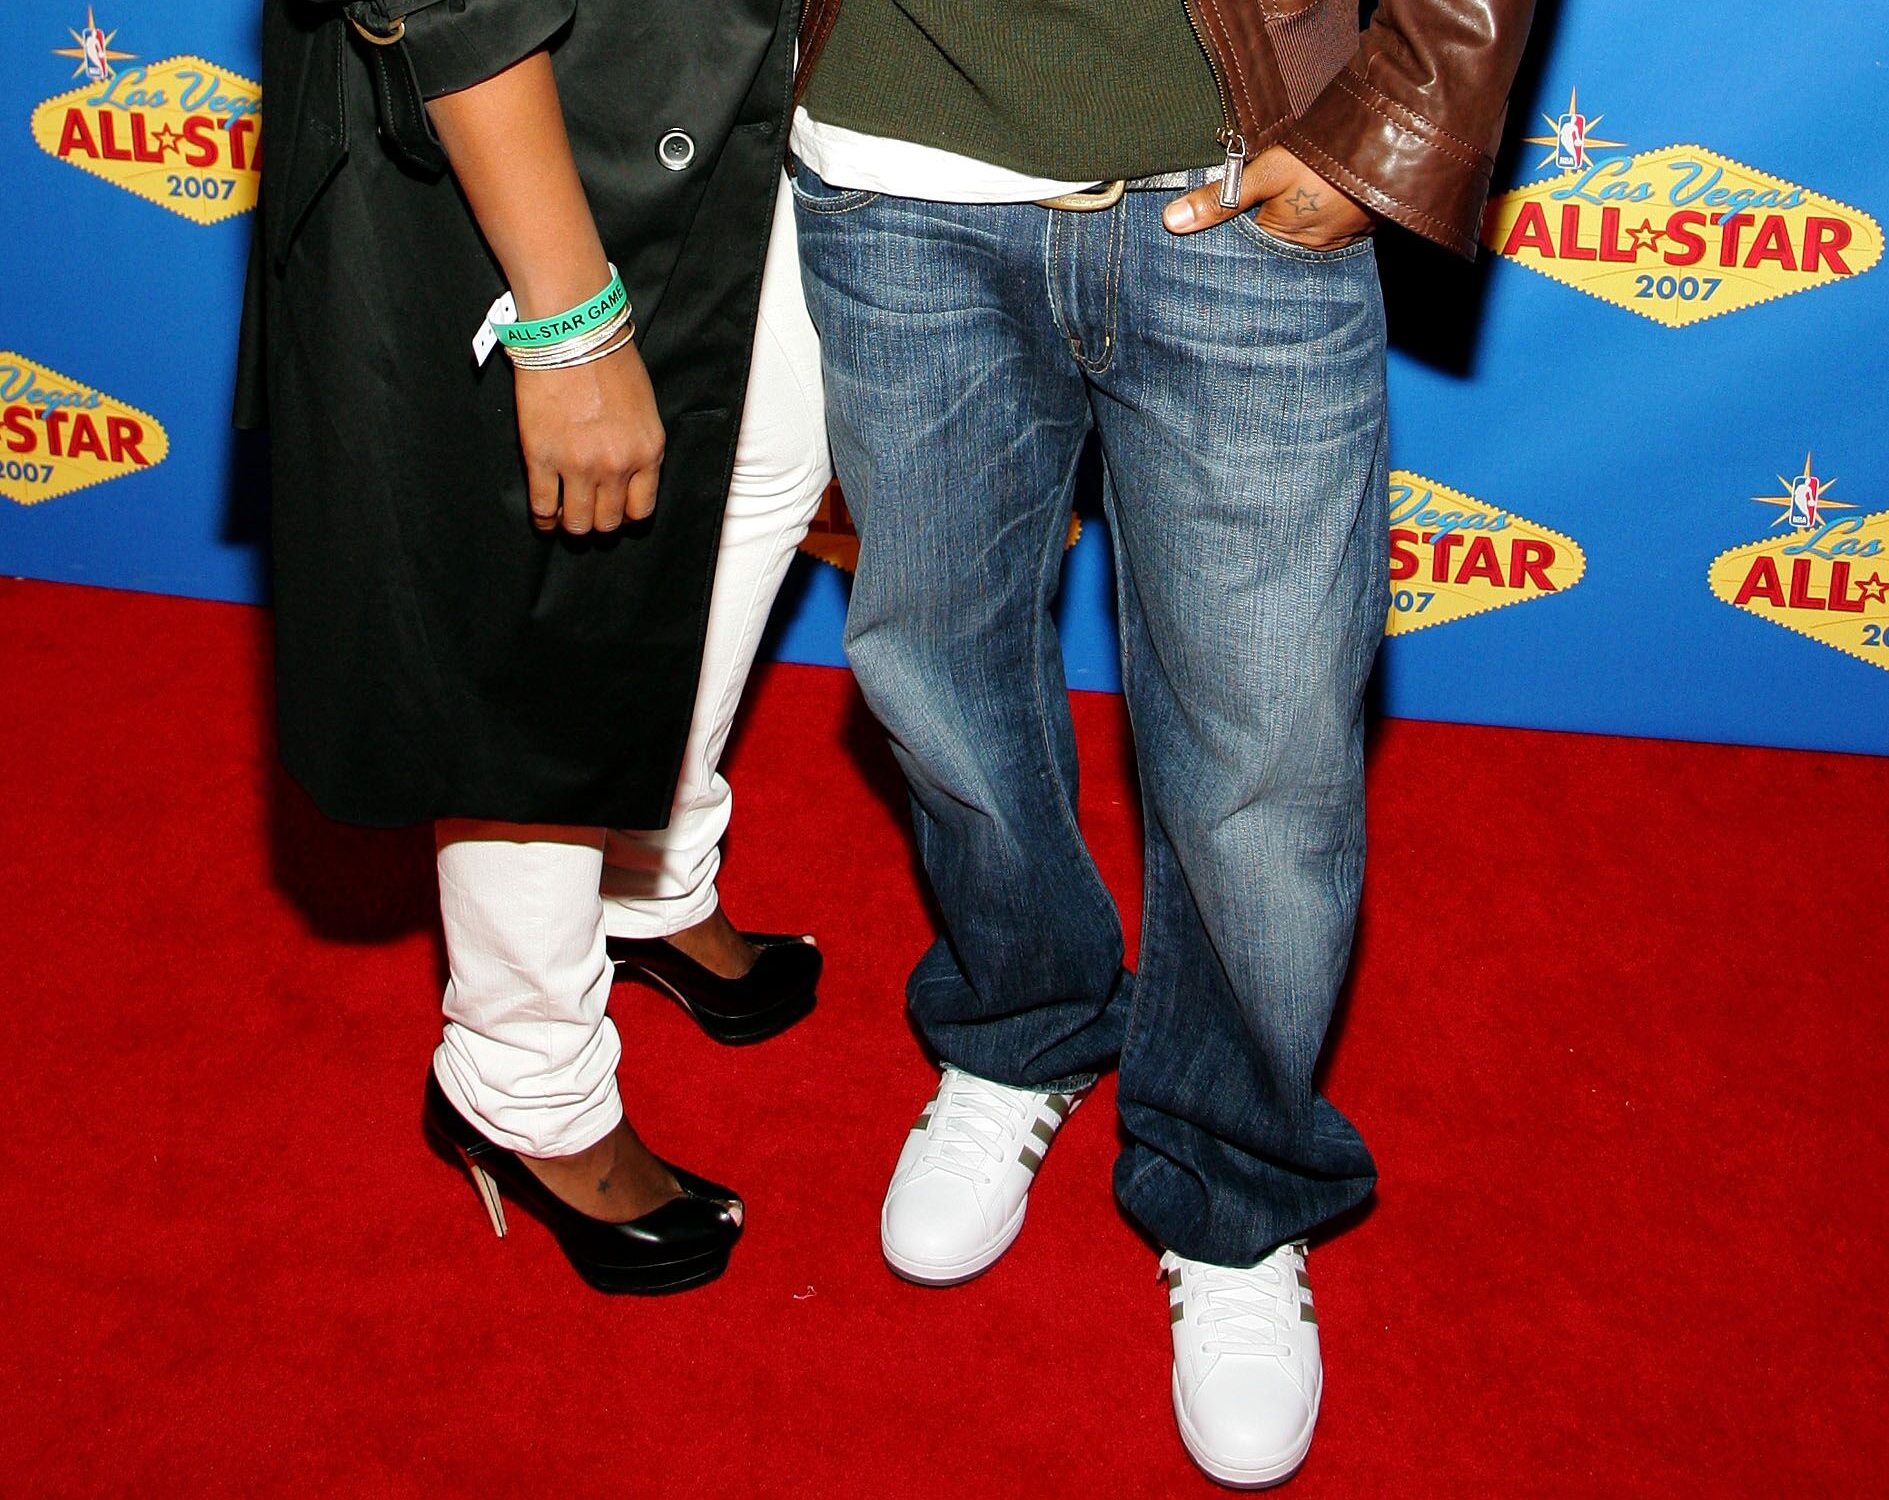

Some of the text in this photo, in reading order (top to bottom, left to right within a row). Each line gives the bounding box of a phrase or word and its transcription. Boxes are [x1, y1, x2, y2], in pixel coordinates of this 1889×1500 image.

[87, 67, 168, 111] Las
[57, 108, 164, 163] ALL
[167, 175, 236, 200] 2007
[1551, 156, 1807, 226] Las Vegas
[1503, 201, 1854, 275] ALL STAR
[507, 283, 625, 341] ALL-STAR GAME
[1635, 274, 1723, 301] 2007
[0, 365, 103, 420] Vegas
[3, 405, 150, 466] STAR
[0, 460, 54, 484] 007
[1389, 529, 1558, 591] STAR
[1782, 516, 1886, 560] Las
[1733, 556, 1865, 613] ALL
